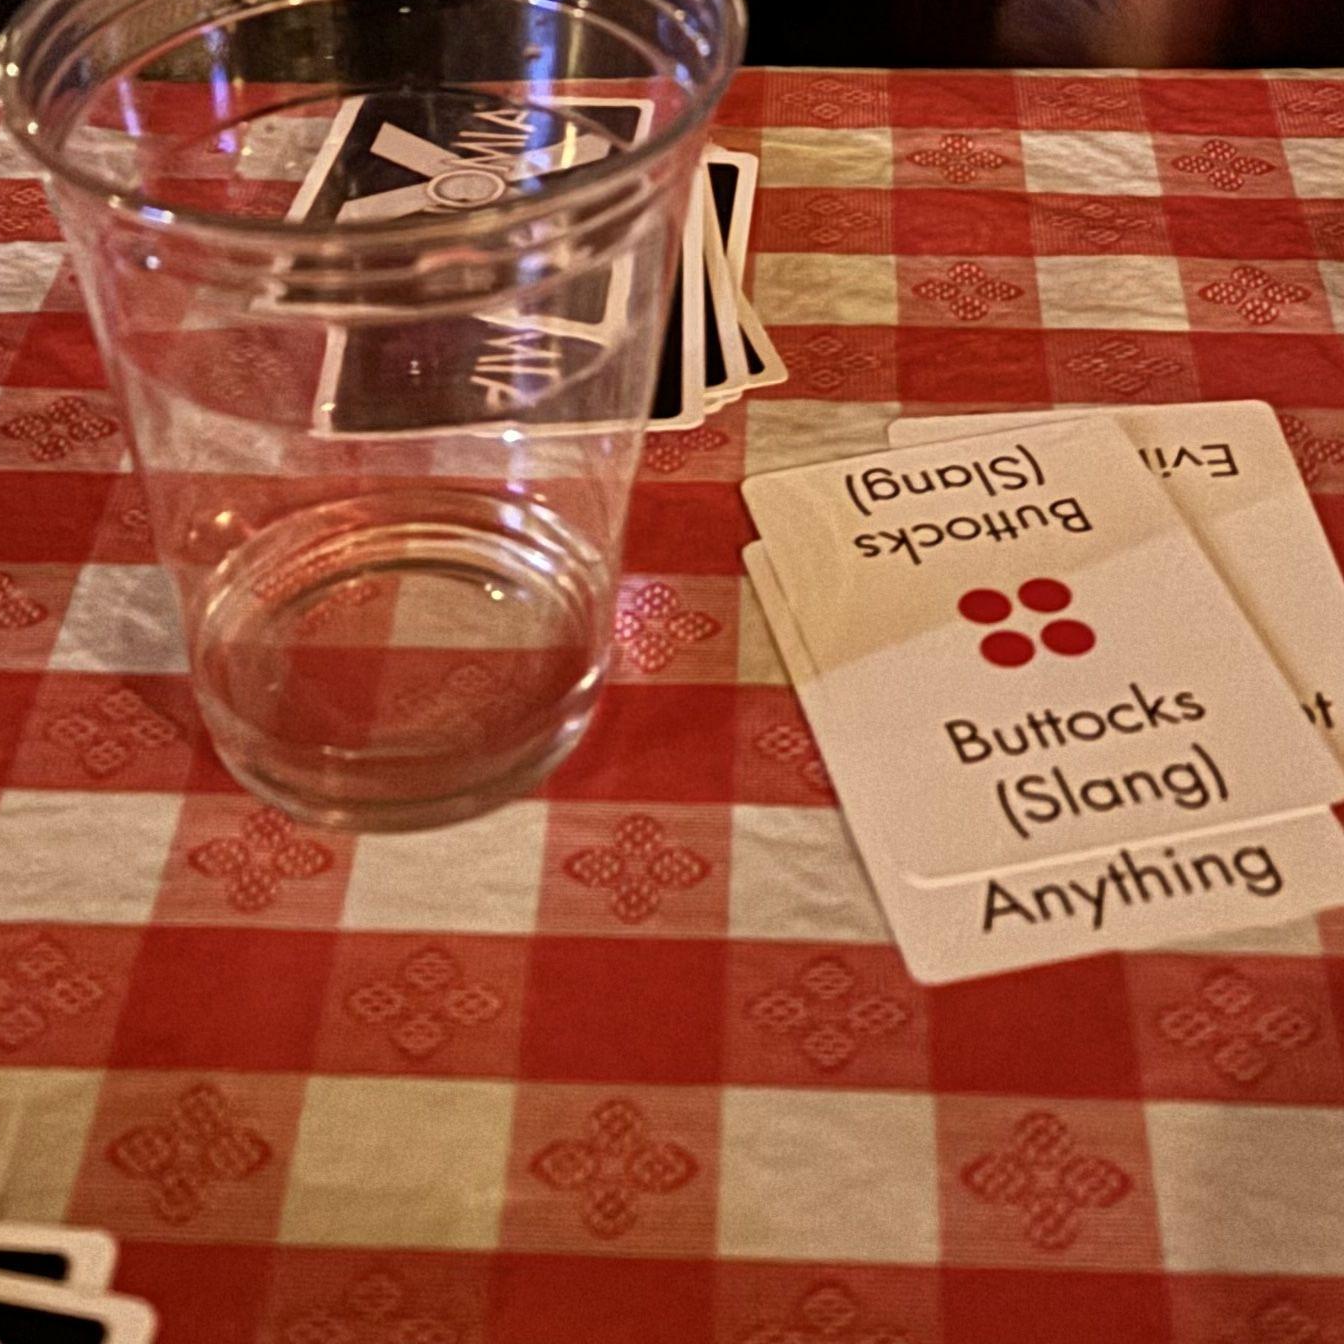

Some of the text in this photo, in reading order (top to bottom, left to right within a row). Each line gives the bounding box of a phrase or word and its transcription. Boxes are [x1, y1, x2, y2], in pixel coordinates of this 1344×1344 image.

[844, 444, 1047, 516] (Slang)
[853, 496, 1094, 566] Buttocks
[943, 681, 1207, 765] Buttocks
[996, 742, 1230, 840] (Slang)
[981, 843, 1284, 934] Anything
